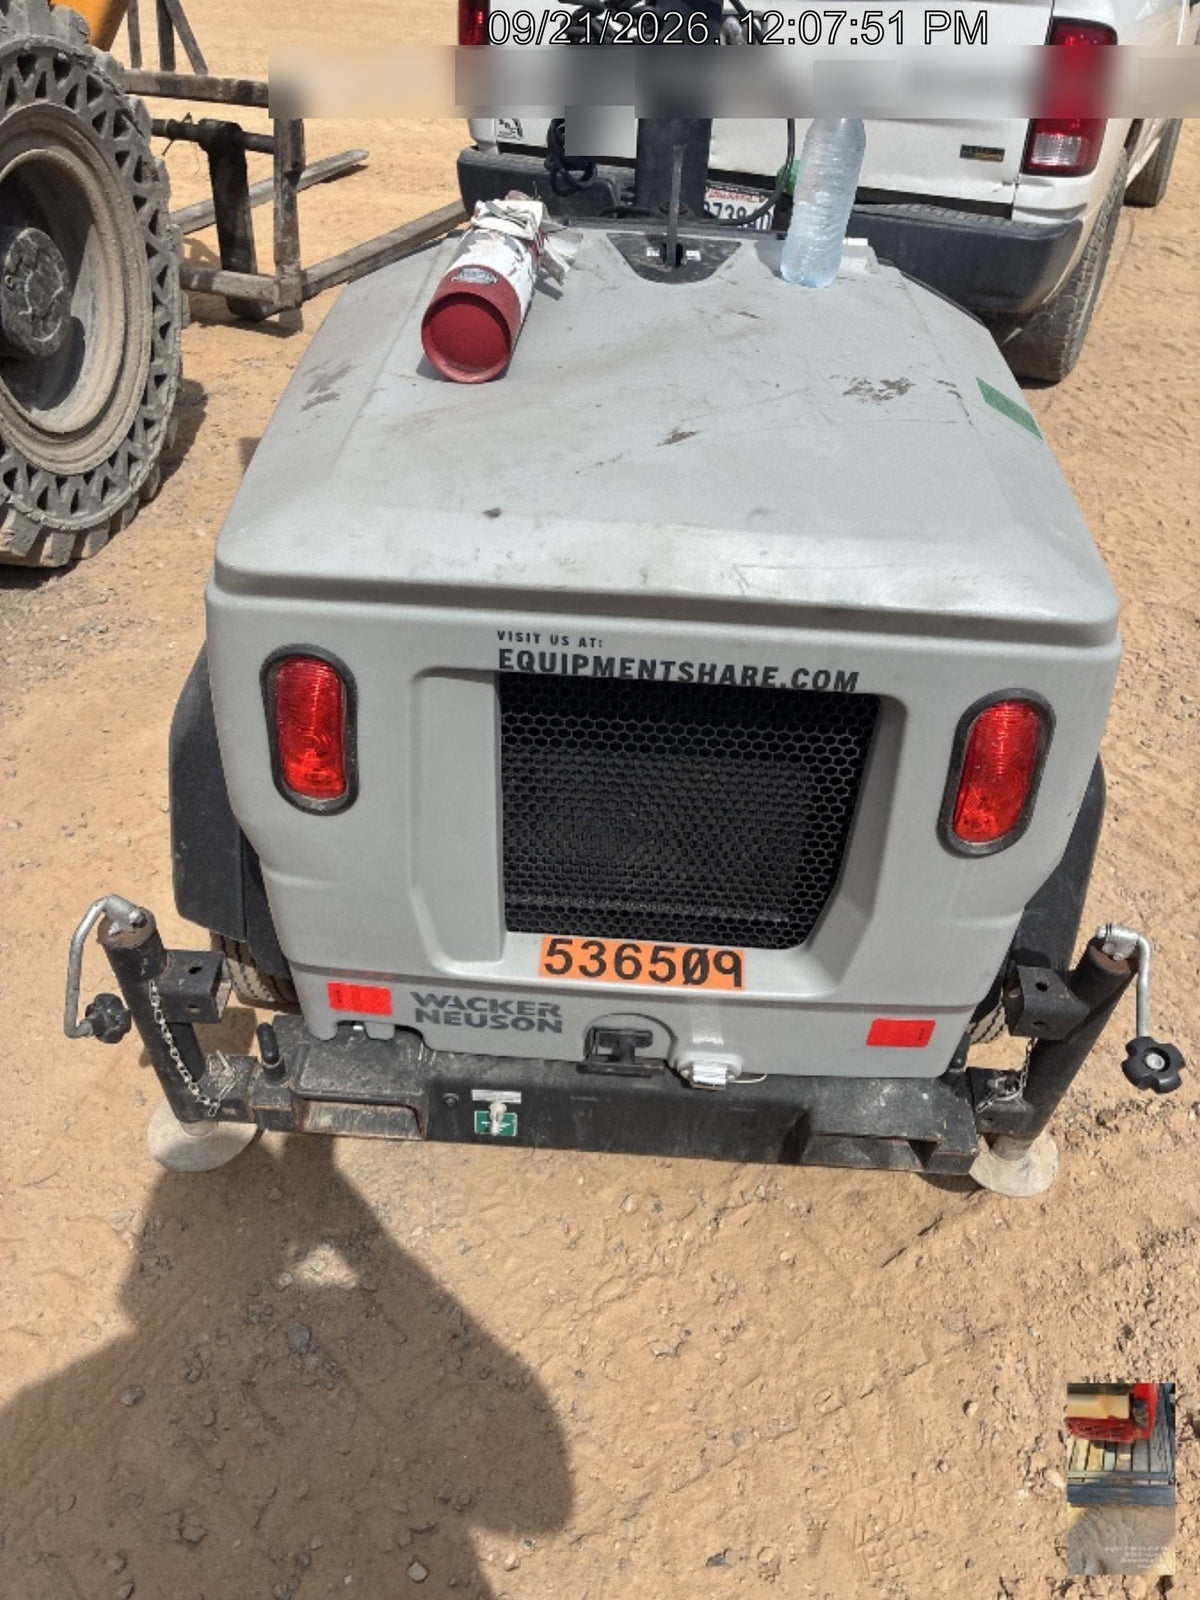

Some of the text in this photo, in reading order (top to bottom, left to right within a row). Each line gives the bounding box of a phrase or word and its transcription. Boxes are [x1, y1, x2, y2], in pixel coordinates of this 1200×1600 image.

[497, 630, 603, 648] VISIT US AT:
[499, 648, 859, 692] EQUIPMENTSHARE.COM
[544, 938, 742, 988] 536509
[410, 991, 562, 1018] WACKER
[415, 1007, 563, 1034] NEUSON
